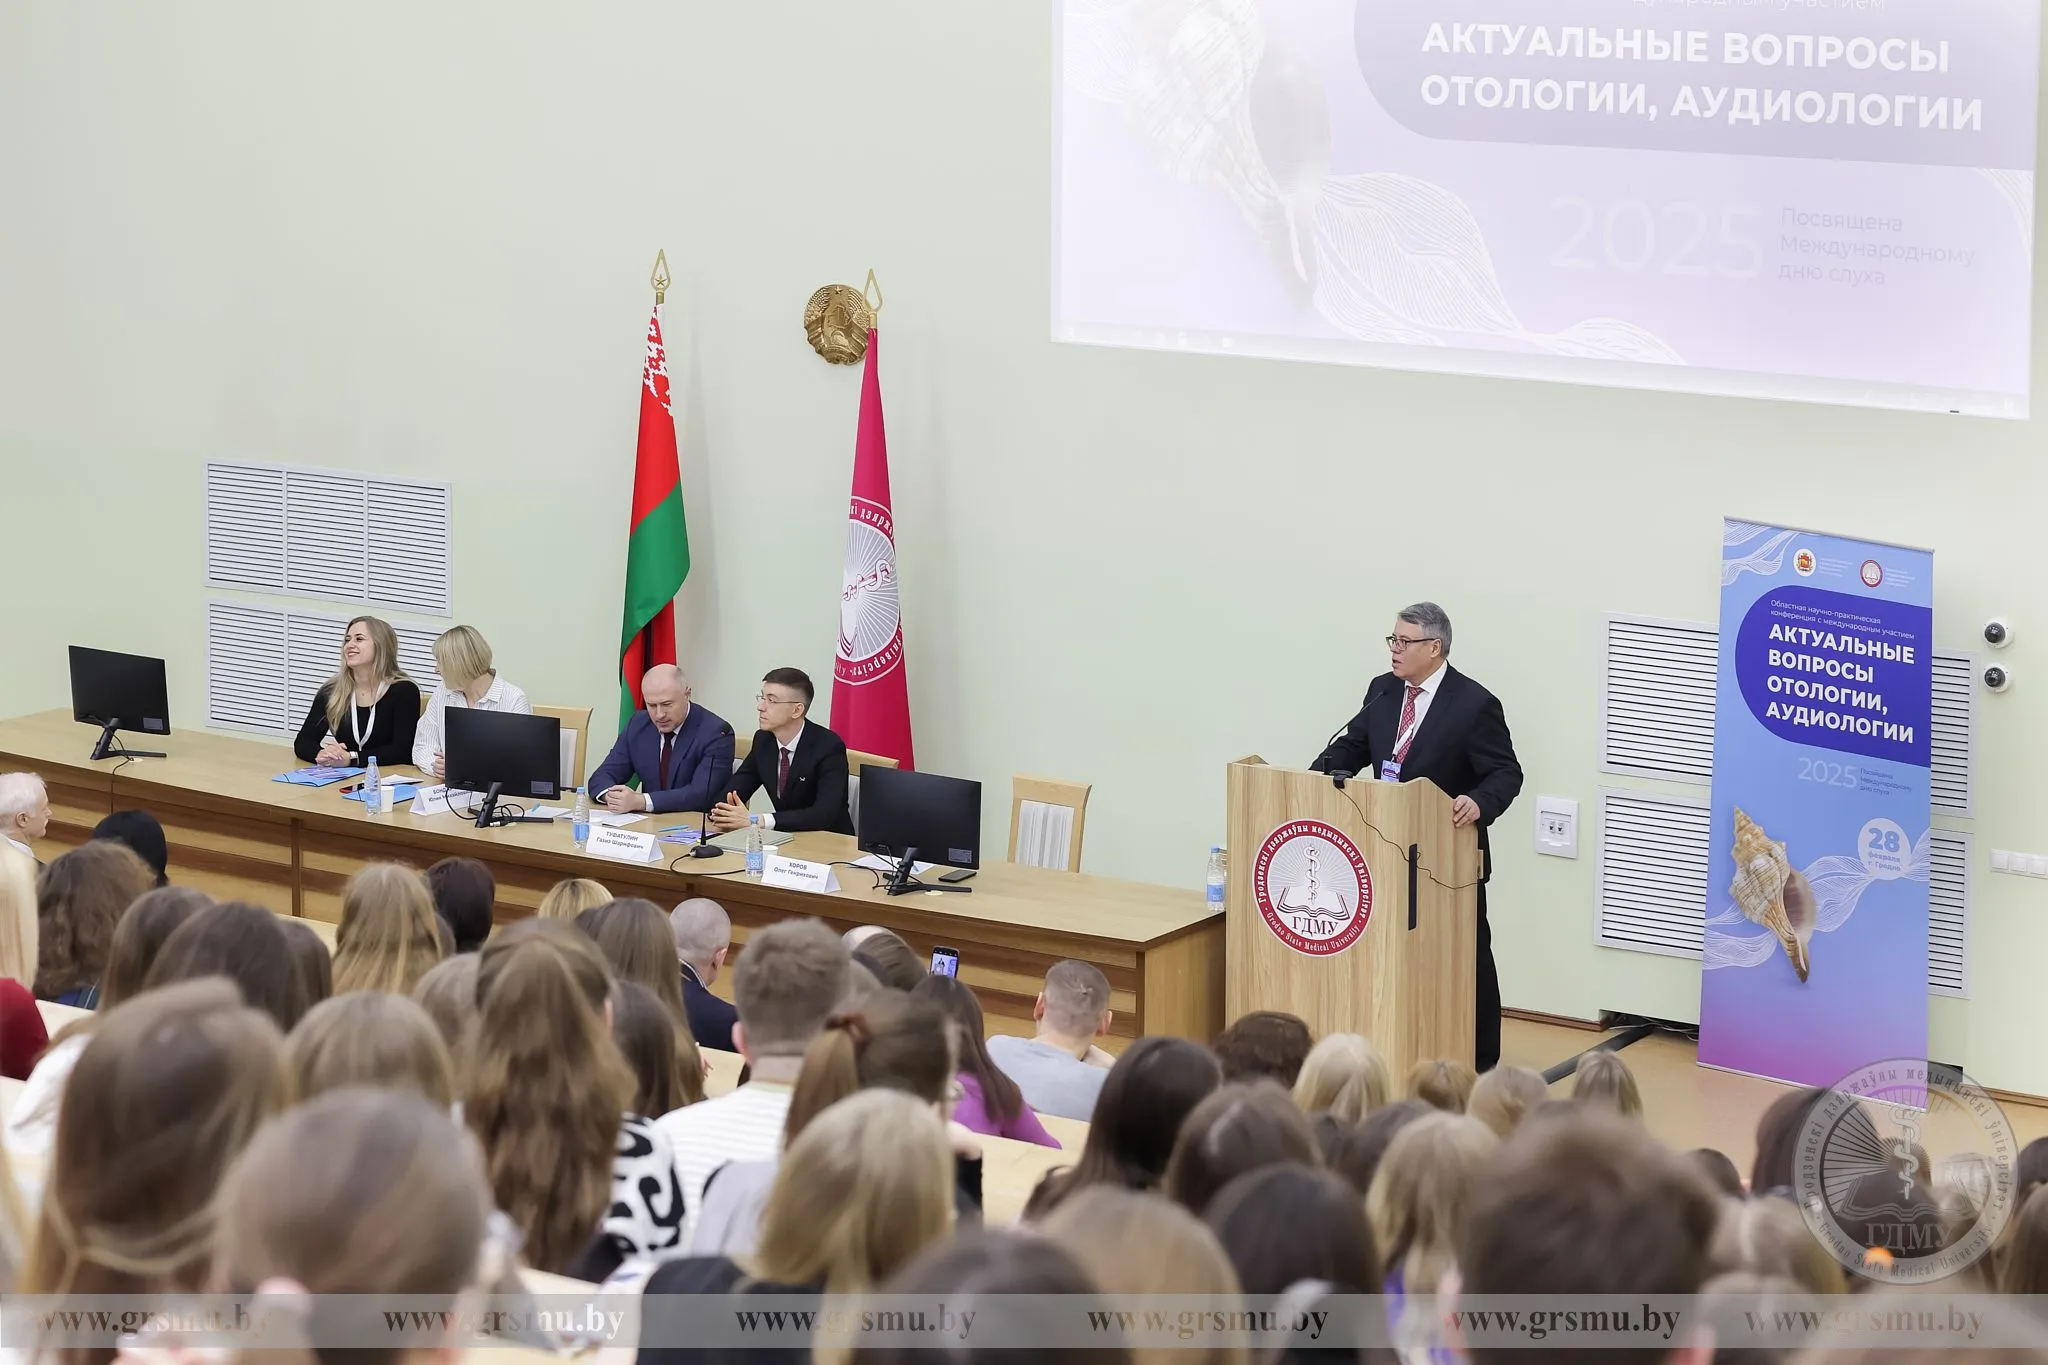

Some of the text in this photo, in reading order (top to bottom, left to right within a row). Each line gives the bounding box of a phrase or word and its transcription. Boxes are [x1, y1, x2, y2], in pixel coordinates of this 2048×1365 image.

[1421, 22, 1949, 73] АКТУАЛЬНЫЕ ВОПРОСЫ
[1421, 74, 1983, 131] ОТОЛОГИИ, АУДИОЛОГИИ
[1781, 206, 1903, 232] Посвящена
[1549, 196, 1762, 280] 2025
[1780, 233, 1976, 267] Международному
[1779, 264, 1886, 287] дню слуха
[1770, 599, 1881, 624] Областная научно-практическая
[1770, 610, 1816, 622] конференция
[1823, 619, 1881, 634] международным
[1881, 628, 1915, 640] участием
[1768, 623, 1915, 664] АКТУАЛЬНЫЕ
[1768, 649, 1874, 683] ВОПРОСЫ
[1767, 675, 1888, 715] ОТОЛОГИИ,
[1765, 701, 1914, 743] АУДИОЛОГИИ
[1798, 757, 1858, 788] 2025
[1868, 827, 1900, 852] 28
[1285, 933, 1302, 946] State
[1304, 940, 1330, 952] Medical
[1331, 925, 1360, 949] University
[1291, 915, 1339, 937] ГДМУ
